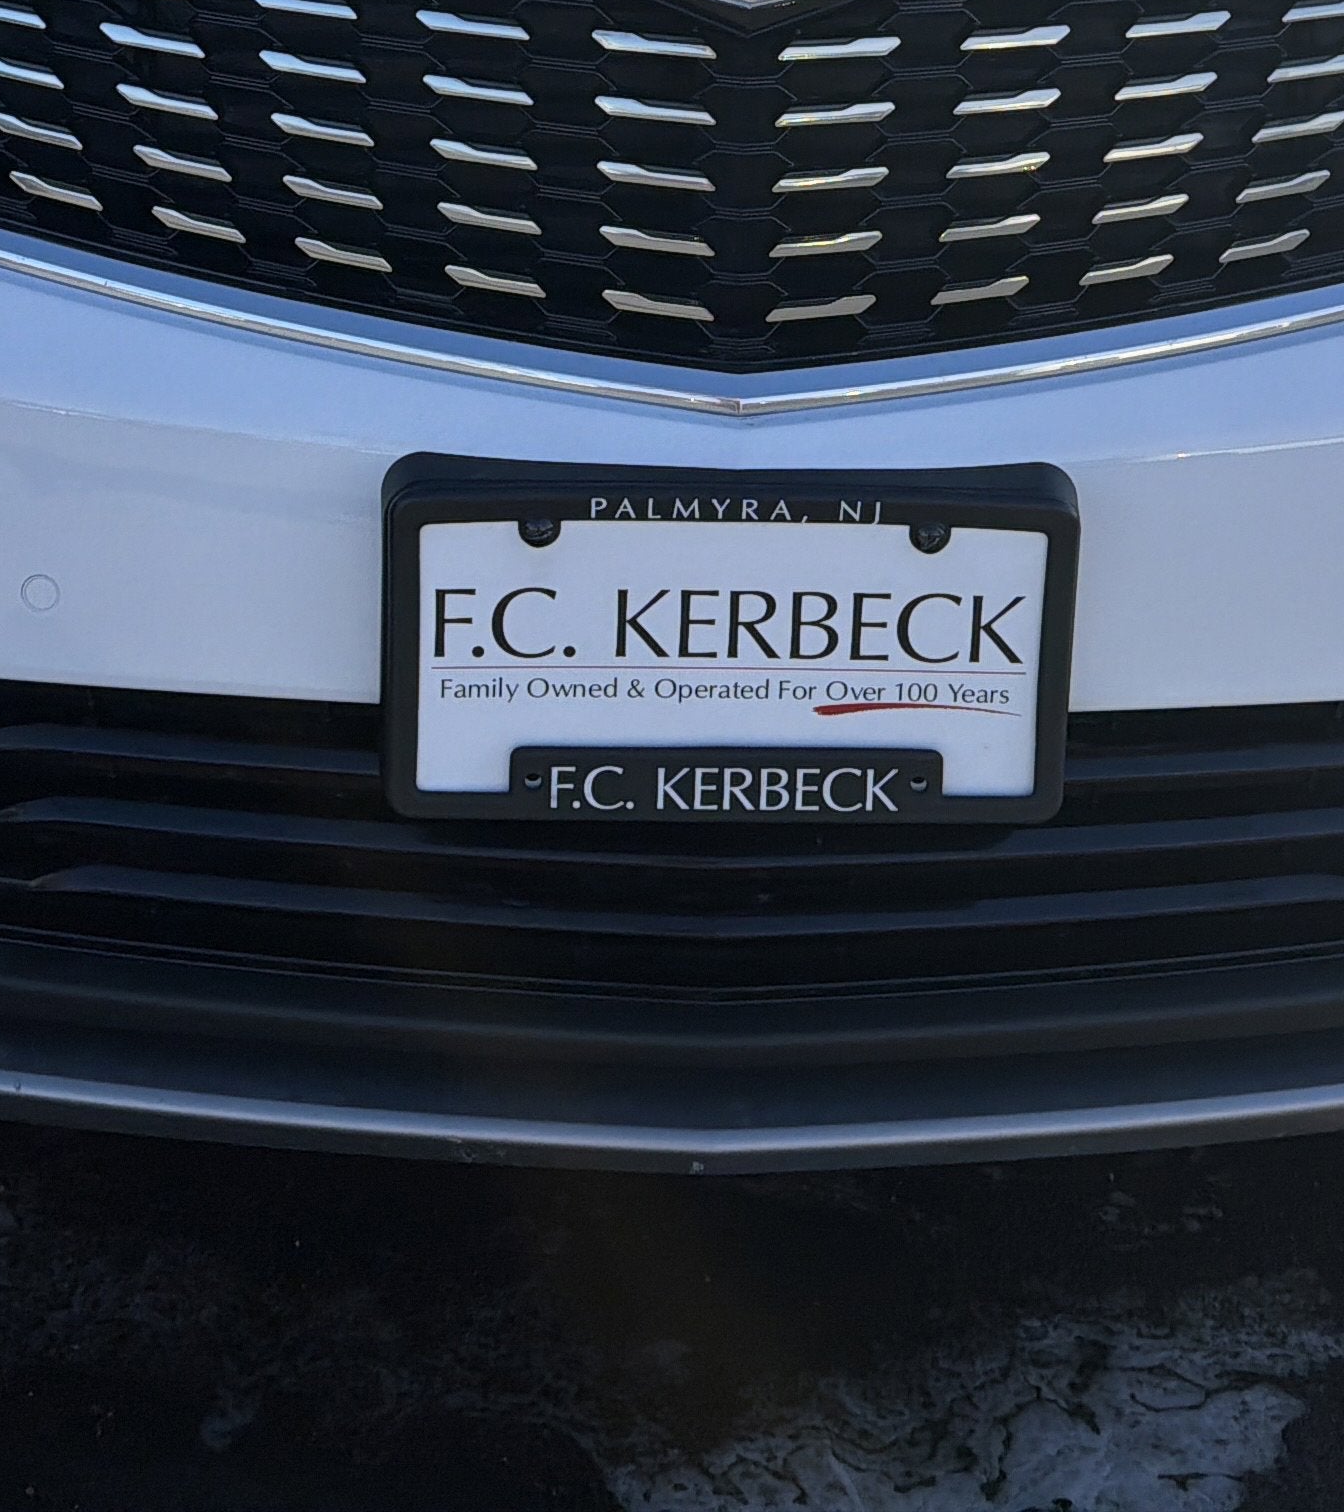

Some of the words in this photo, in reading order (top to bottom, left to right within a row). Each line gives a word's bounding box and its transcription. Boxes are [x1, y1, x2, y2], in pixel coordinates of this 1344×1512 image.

[589, 496, 810, 524] PALMYRA,
[838, 500, 884, 525] NJ
[431, 586, 577, 659] F.C.
[614, 587, 1028, 665] KERBECK
[440, 677, 519, 703] Family
[526, 677, 618, 699] Owned
[626, 678, 646, 699] &
[653, 678, 770, 704] Operated
[778, 680, 817, 700] For
[825, 680, 886, 702] Over
[895, 682, 939, 703] 100
[948, 682, 1011, 705] Years
[549, 765, 635, 811] F.C.
[655, 766, 899, 813] KERBECK
